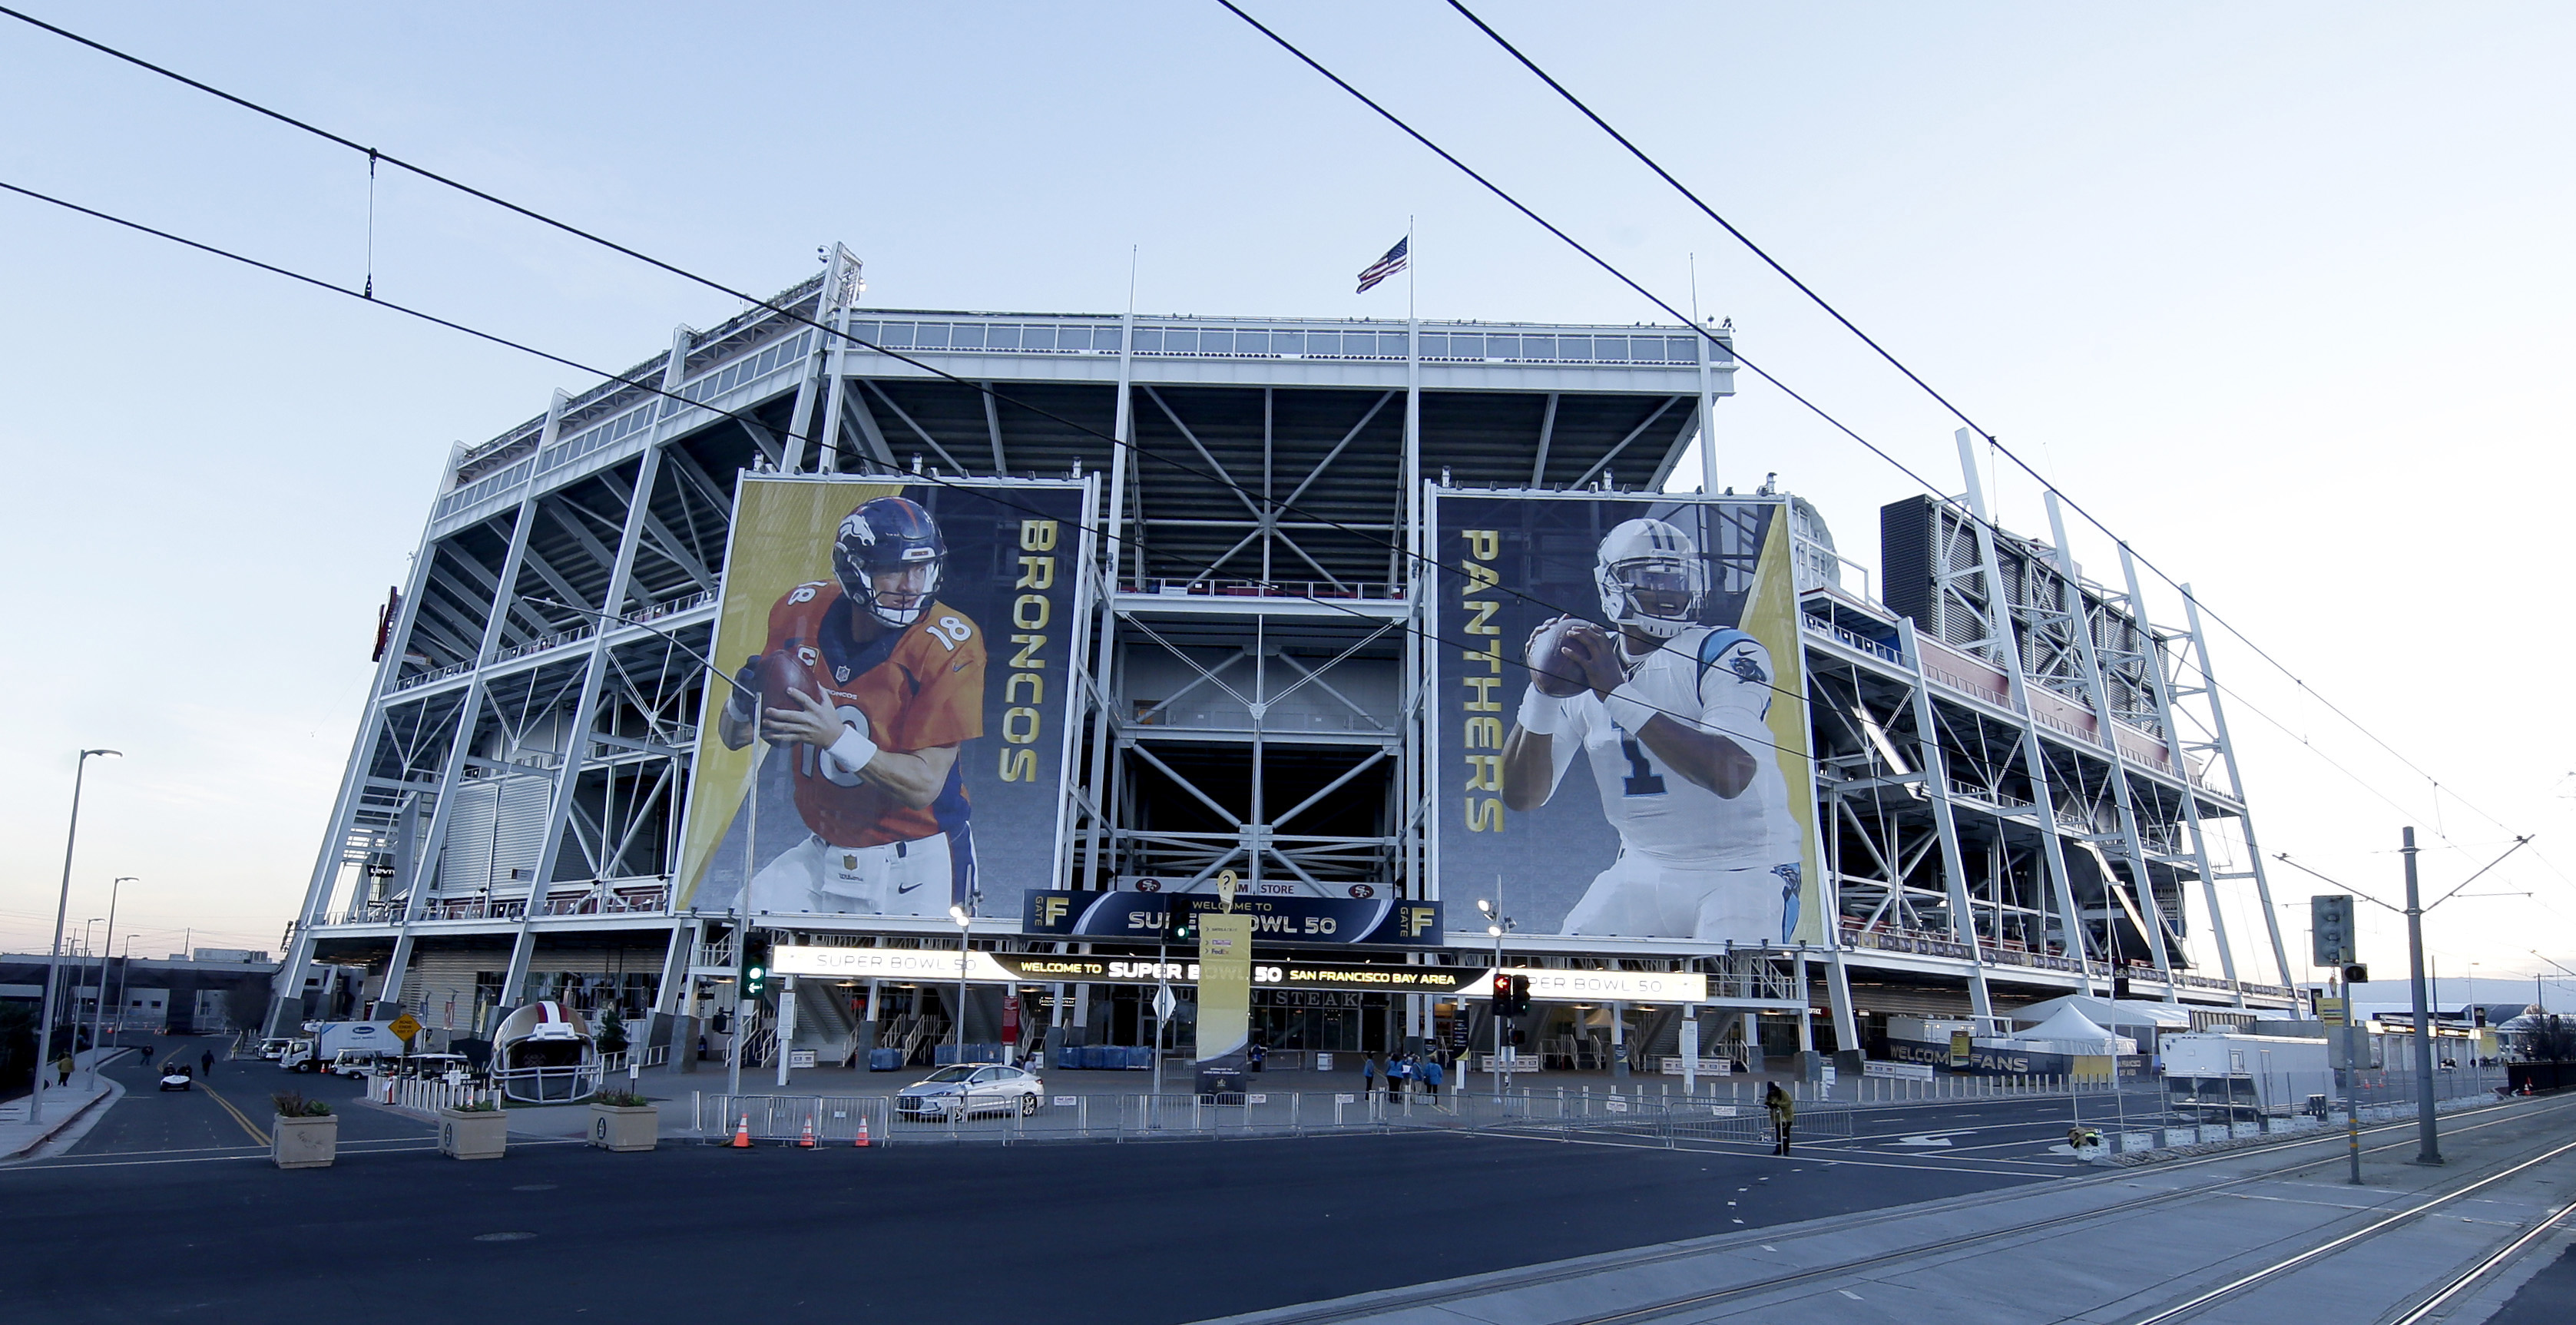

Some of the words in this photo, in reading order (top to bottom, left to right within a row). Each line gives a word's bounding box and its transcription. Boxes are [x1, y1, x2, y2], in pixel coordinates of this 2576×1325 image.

[925, 616, 972, 651] 18
[797, 647, 816, 667] C
[998, 519, 1058, 783] BRONCOS
[1461, 529, 1504, 833] PANTHERS
[1260, 884, 1294, 894] STORE
[1035, 896, 1044, 926] GATE
[1045, 897, 1070, 926] F
[1255, 903, 1272, 912] TO
[1128, 911, 1200, 931] SUE
[1250, 914, 1298, 934] OWL
[1305, 916, 1337, 935] 50
[1400, 906, 1409, 937] GATE
[1412, 907, 1435, 937] F
[817, 954, 882, 968] SUPER
[891, 956, 945, 971] BOWL
[954, 958, 977, 971] 50
[1021, 962, 1082, 973] WELCOME
[1084, 963, 1102, 974] TO
[1108, 962, 1183, 979] SUPER
[1254, 966, 1283, 982] 50
[1290, 970, 1316, 981] SAN
[1319, 971, 1391, 983] FRANCISCO
[1392, 973, 1418, 984] BAY
[1419, 974, 1456, 985] AREA
[1528, 976, 1565, 989] PER
[1574, 978, 1631, 992] BOWL
[1639, 980, 1663, 992] 50
[1275, 990, 1358, 1007] STEAK
[1890, 1044, 1950, 1065] WELCOM
[1971, 1053, 2029, 1073] FANS
